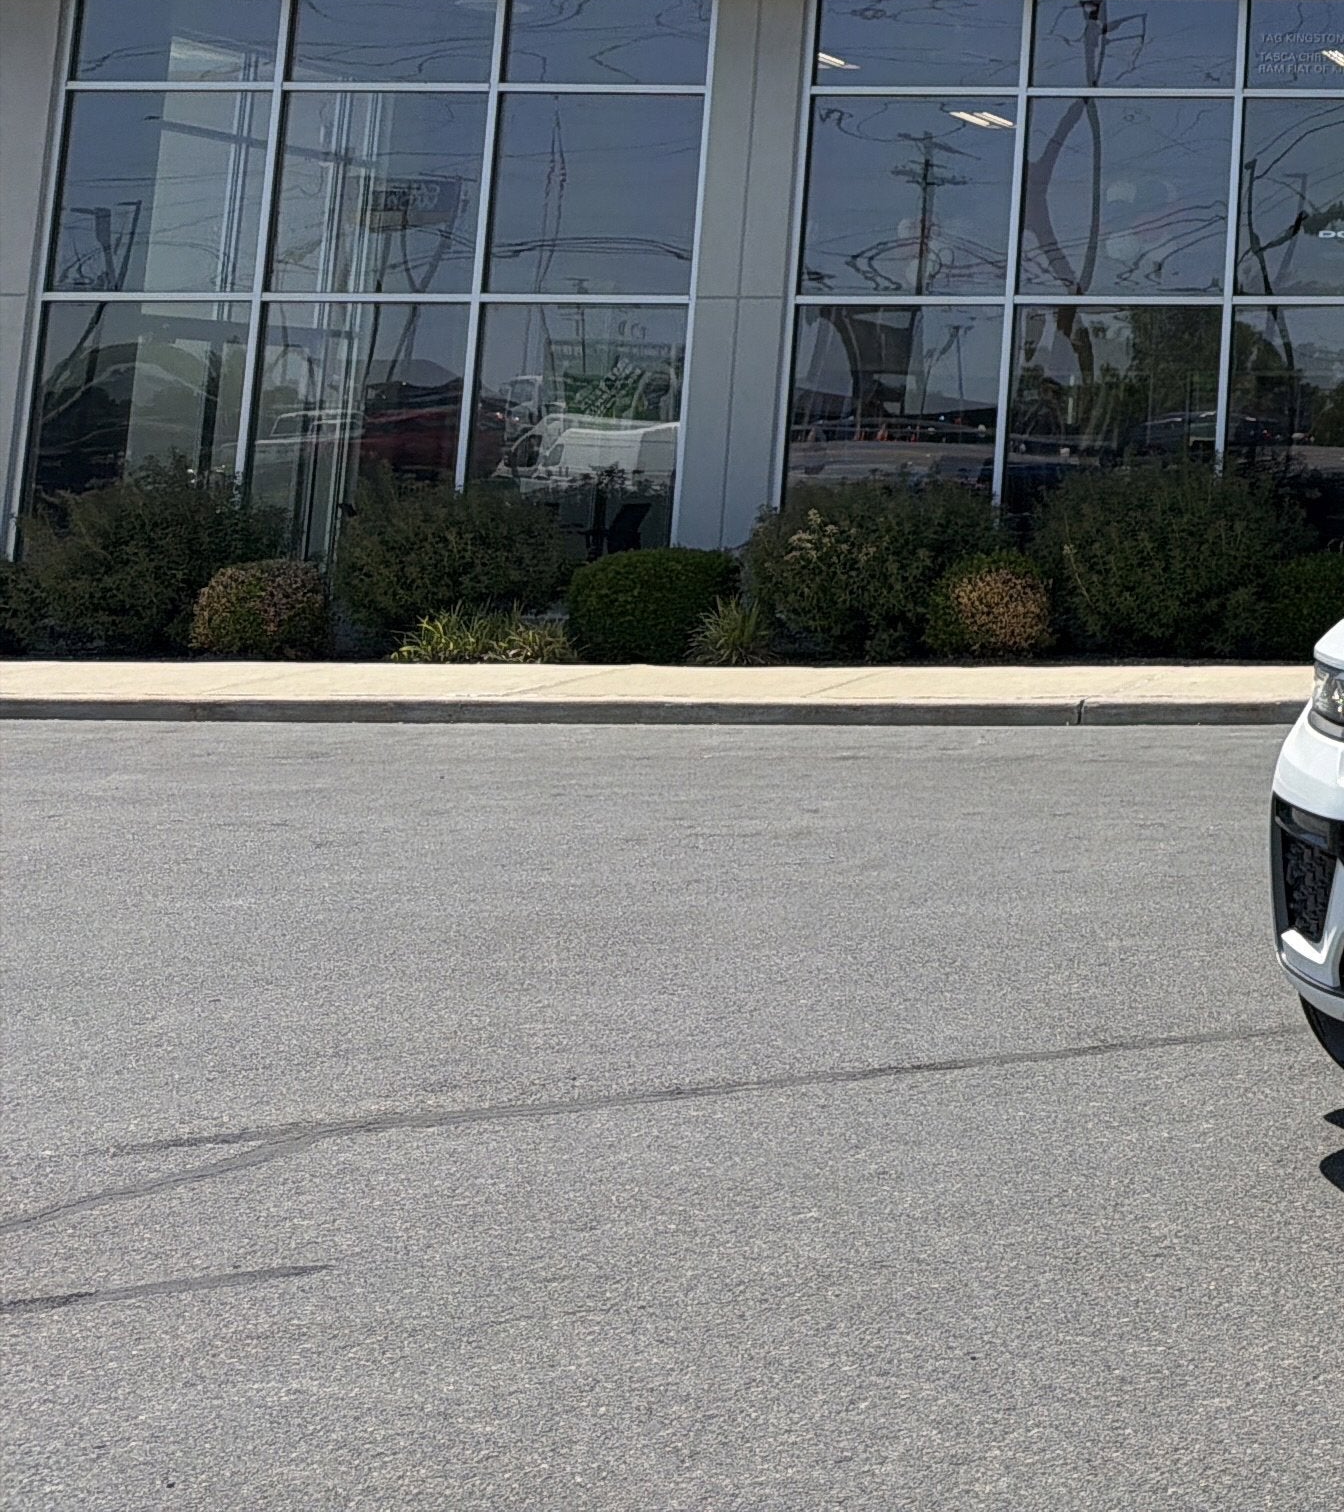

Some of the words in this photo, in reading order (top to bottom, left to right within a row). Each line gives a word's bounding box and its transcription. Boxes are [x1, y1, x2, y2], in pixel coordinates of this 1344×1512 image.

[1261, 33, 1283, 43] TAG
[1285, 33, 1344, 44] KINGSTON
[1259, 52, 1296, 62] TASCA
[1258, 64, 1285, 74] RAM
[1287, 64, 1309, 74] FIAT
